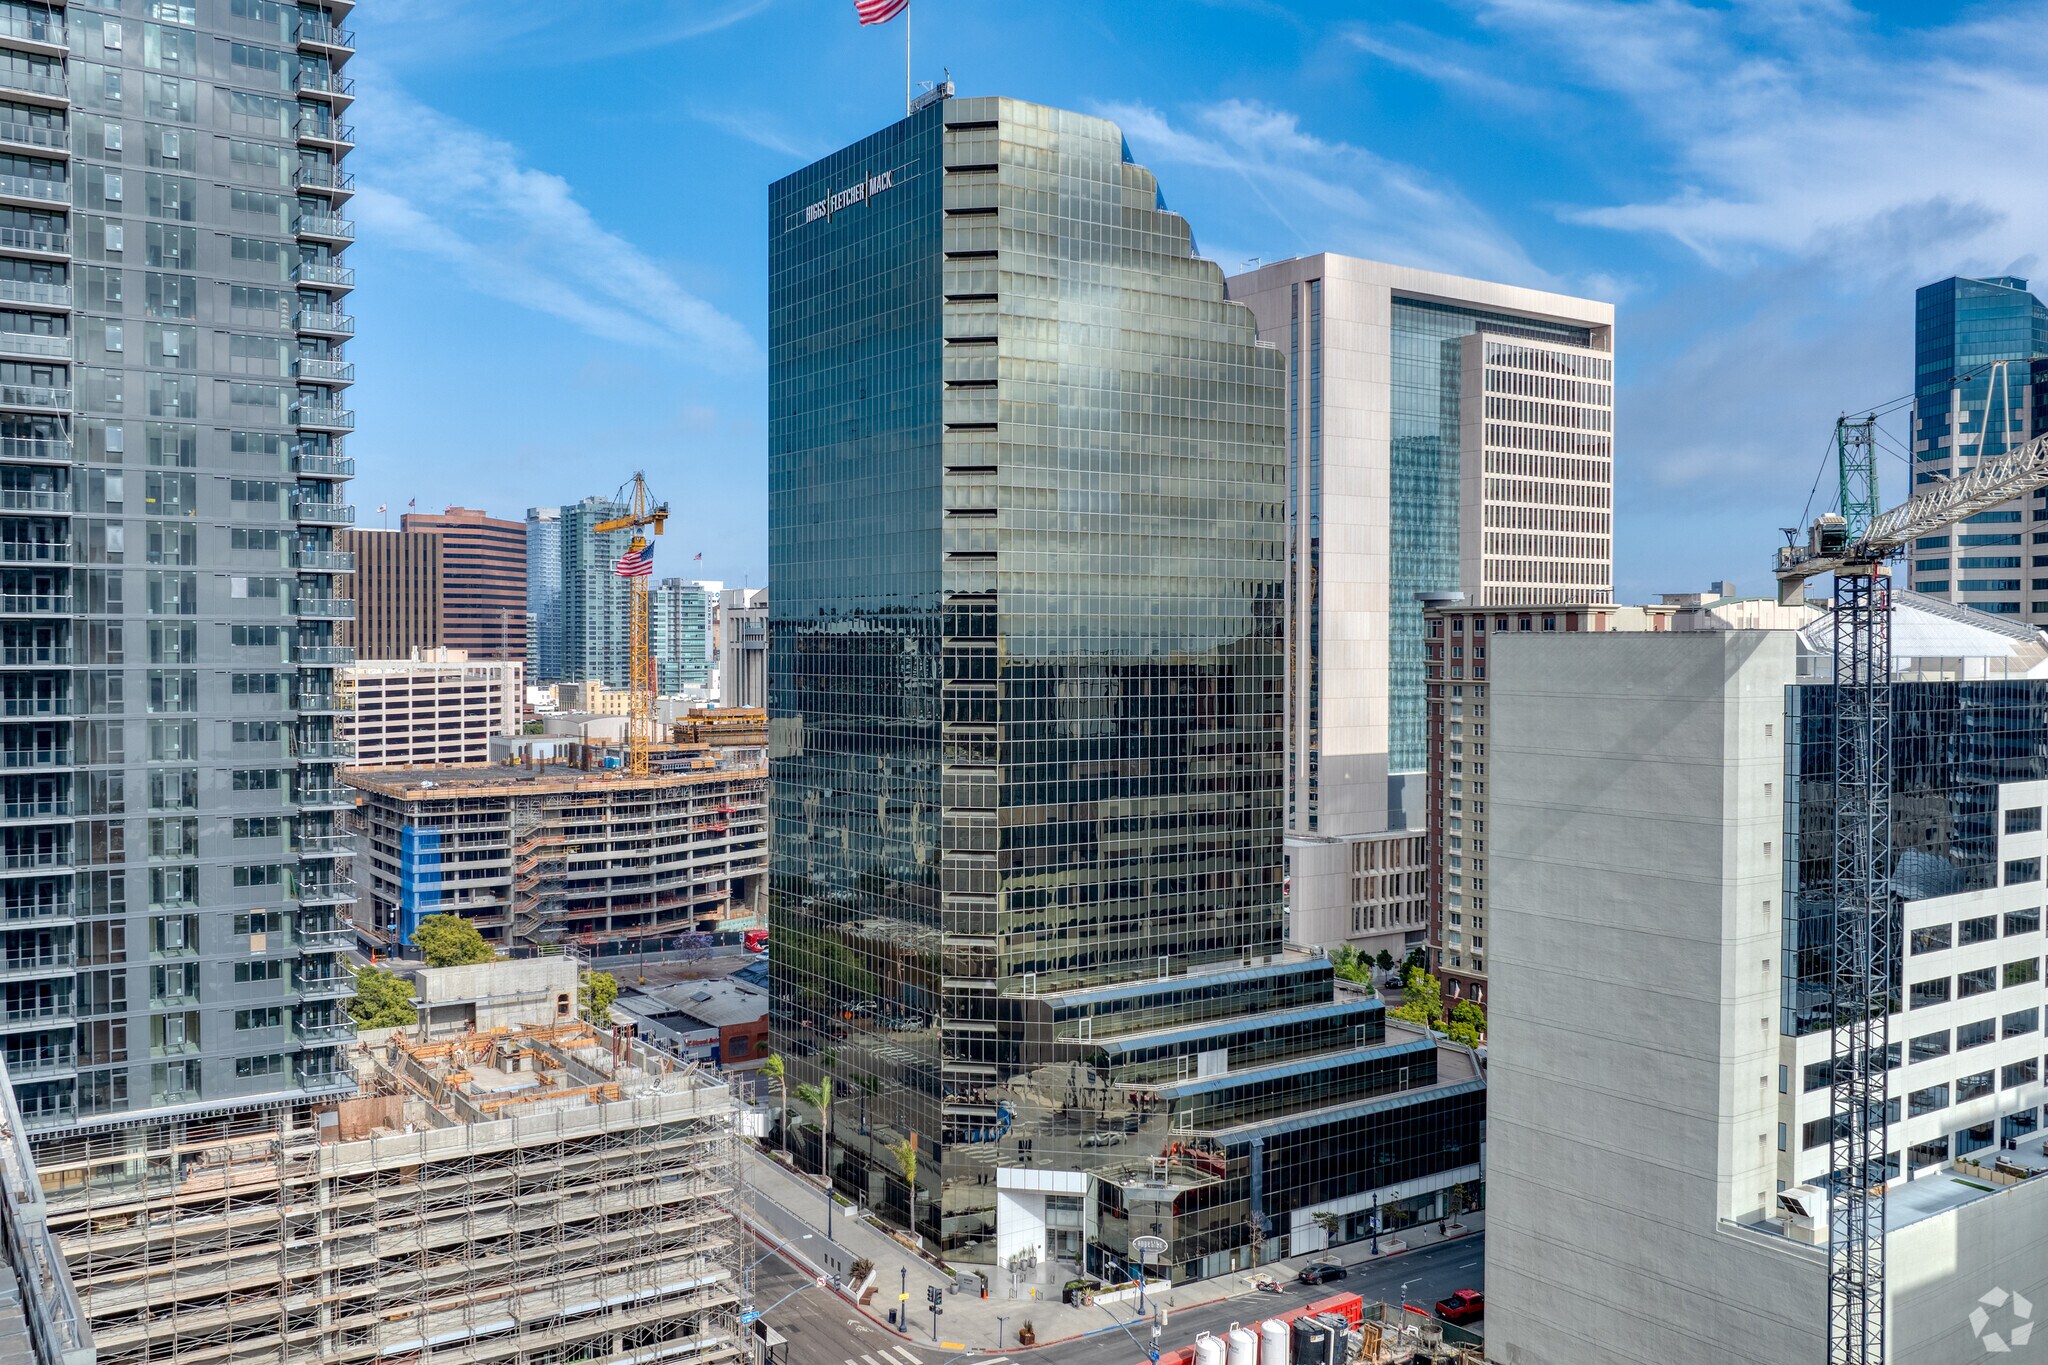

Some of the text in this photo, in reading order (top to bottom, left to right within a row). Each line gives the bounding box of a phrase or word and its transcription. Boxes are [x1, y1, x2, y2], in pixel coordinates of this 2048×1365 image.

[806, 169, 893, 224] HIGGS FLETCHER MACK
